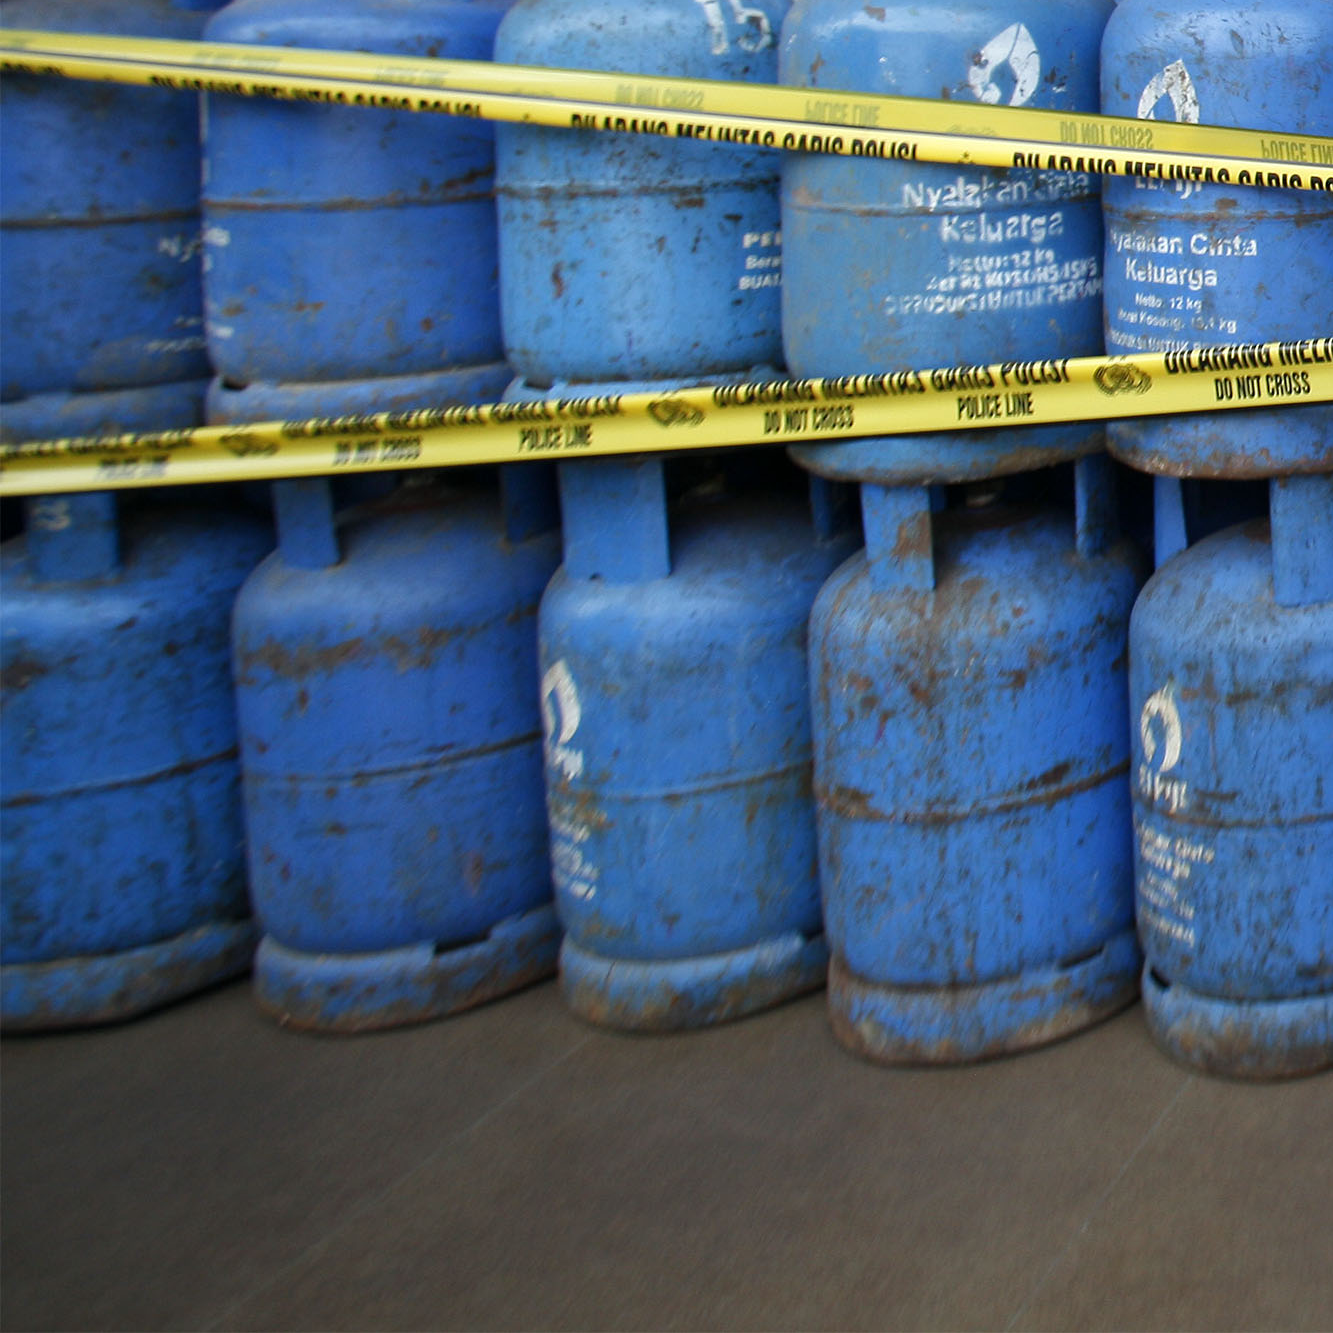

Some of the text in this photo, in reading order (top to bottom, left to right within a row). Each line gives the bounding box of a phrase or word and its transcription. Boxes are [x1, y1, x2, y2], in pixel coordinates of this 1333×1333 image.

[941, 212, 1065, 244] Keluarga
[1190, 232, 1258, 257] Cinta
[1124, 257, 1218, 290] Keluarga
[1214, 371, 1311, 402] DO NOT CROSS
[956, 391, 1034, 421] POLICE LINE
